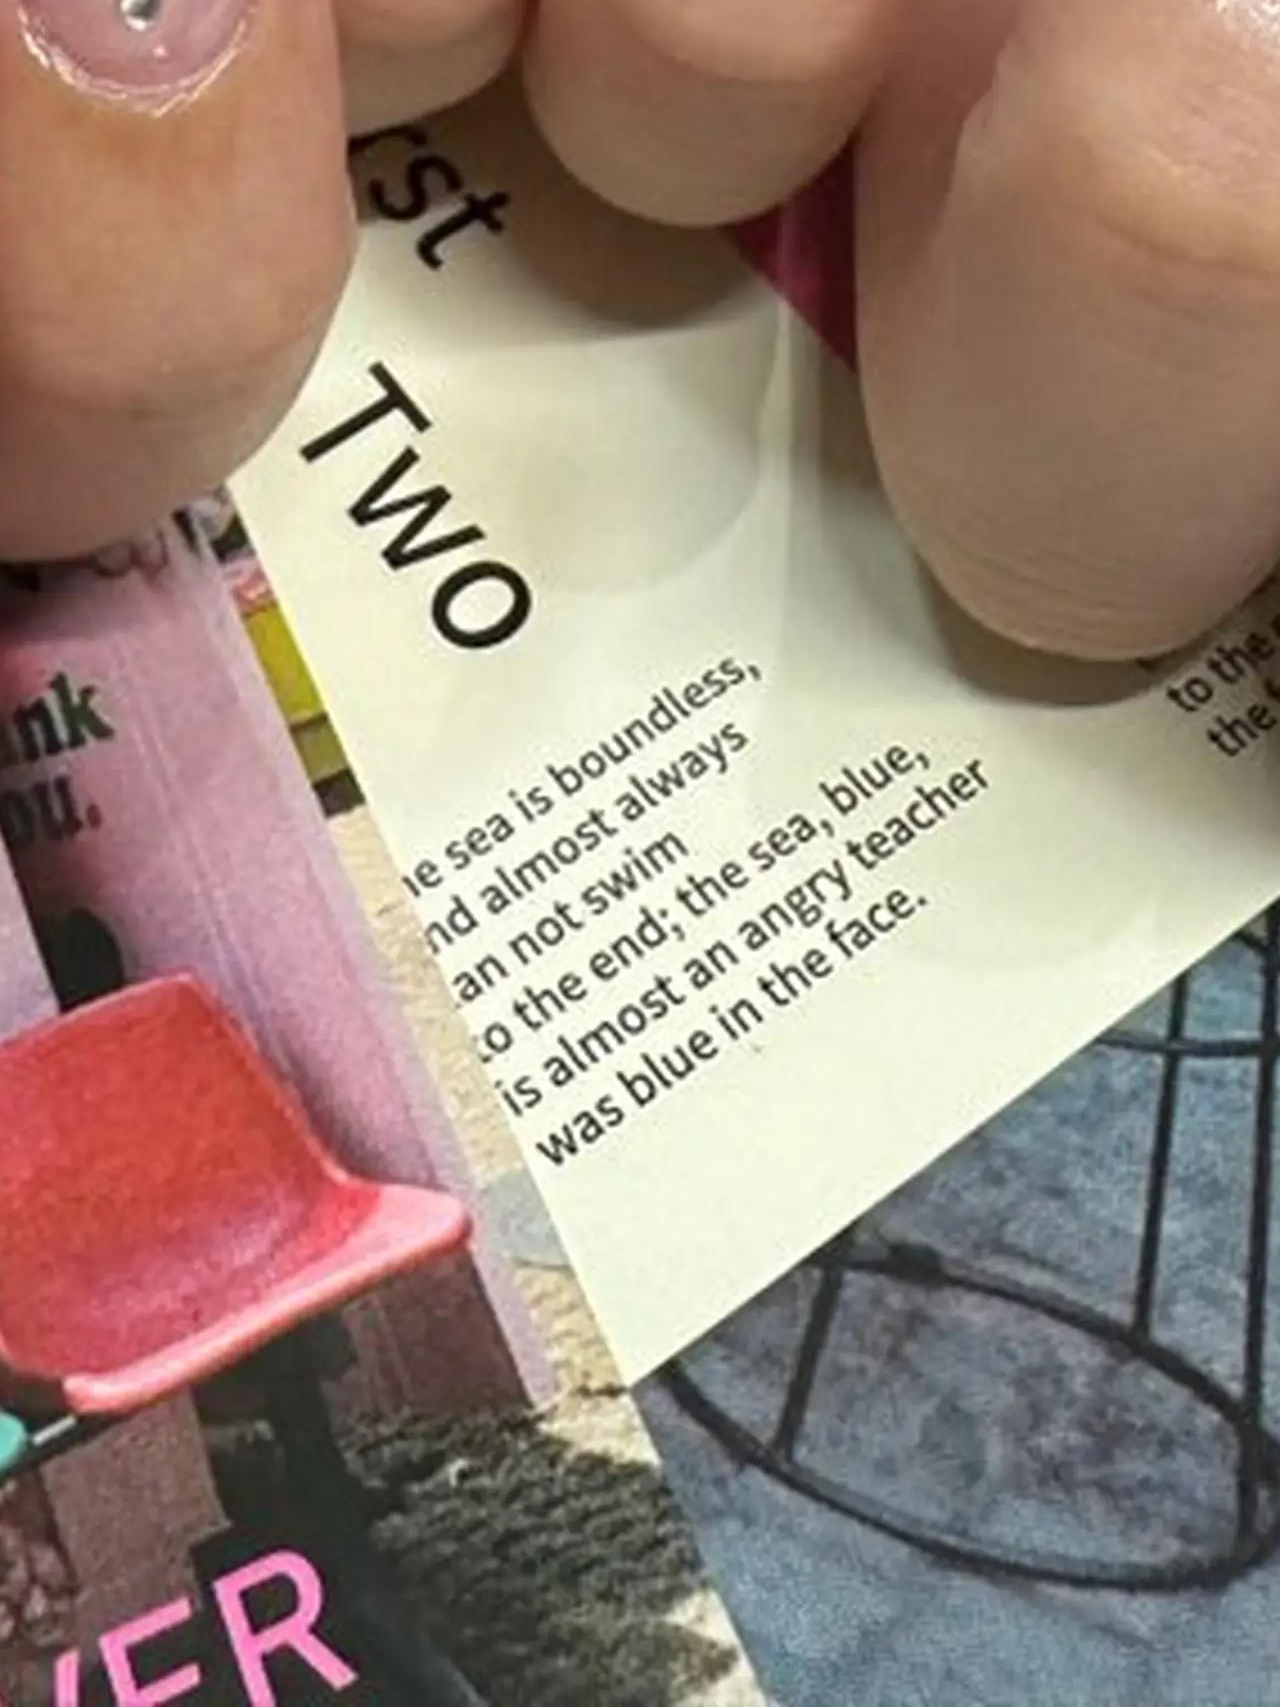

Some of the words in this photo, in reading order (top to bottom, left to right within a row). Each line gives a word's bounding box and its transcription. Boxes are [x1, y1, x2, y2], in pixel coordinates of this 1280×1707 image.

[347, 122, 513, 273] rst
[401, 857, 445, 899] e
[443, 810, 516, 872] sea
[507, 788, 555, 823] is
[545, 656, 763, 799] boundless,
[1166, 673, 1214, 714] to
[1207, 631, 1278, 689] the
[1206, 700, 1280, 758] the
[422, 893, 481, 955] nd
[479, 808, 619, 916] almost
[614, 720, 750, 822] always
[450, 952, 511, 1005] an
[508, 900, 587, 966] not
[579, 829, 691, 918] swim
[493, 1073, 545, 1120] is
[542, 972, 688, 1089] almost
[682, 939, 741, 991] an
[736, 857, 853, 953] angry
[844, 757, 991, 871] teacher
[512, 983, 589, 1033] the
[588, 904, 687, 982] end;
[674, 872, 751, 918] the
[746, 812, 837, 872] sea,
[817, 743, 932, 817] blue,
[534, 1092, 627, 1168] was
[614, 1028, 720, 1108] blue
[707, 997, 765, 1041] in
[756, 947, 836, 1008] the
[823, 887, 929, 961] face.
